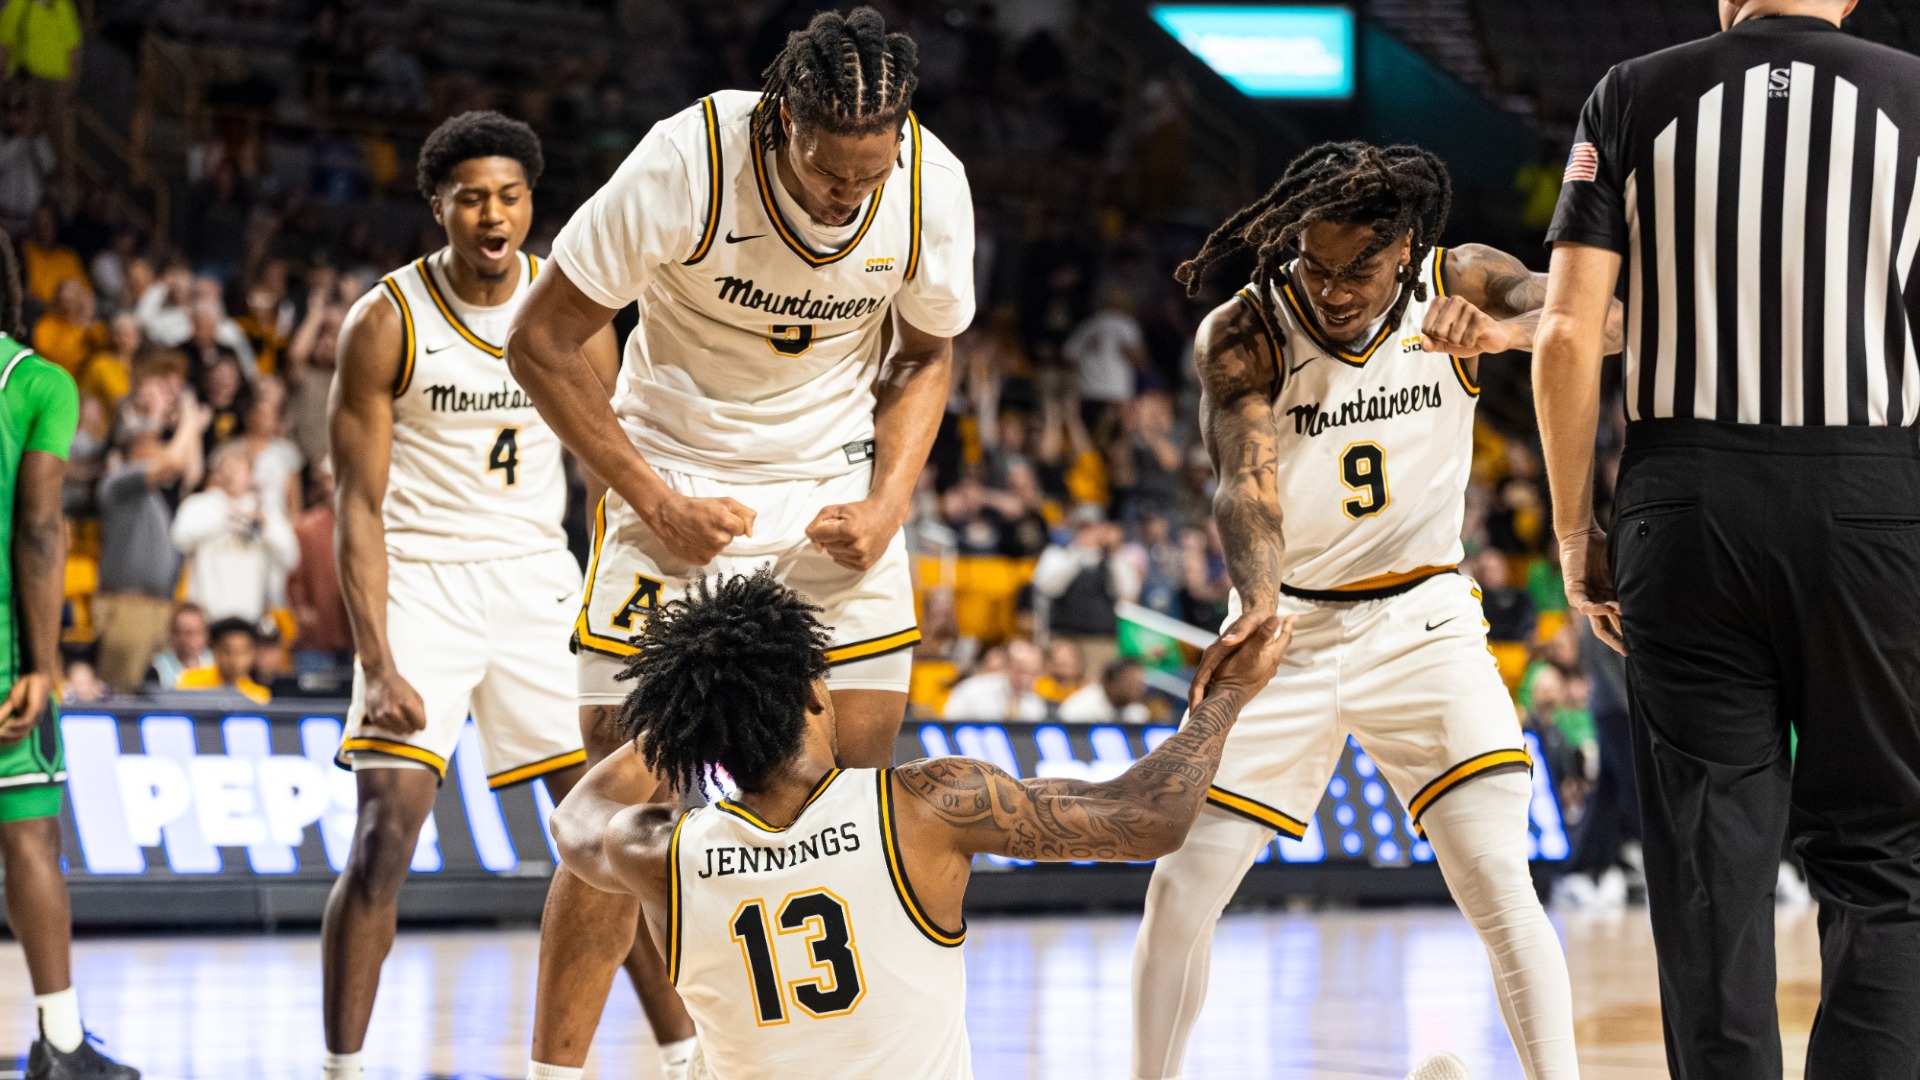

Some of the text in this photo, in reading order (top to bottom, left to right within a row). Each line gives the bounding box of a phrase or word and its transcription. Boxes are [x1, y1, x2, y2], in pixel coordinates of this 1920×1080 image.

[865, 257, 895, 273] SBC
[1401, 336, 1422, 353] SB
[423, 381, 535, 412] Mountai
[1286, 381, 1442, 437] Mountaineers
[485, 424, 521, 490] 4
[1338, 440, 1391, 521] 9
[609, 572, 665, 632] A
[115, 755, 437, 847] PEP
[698, 822, 861, 879] JENNINGS
[728, 886, 867, 1028] 13
